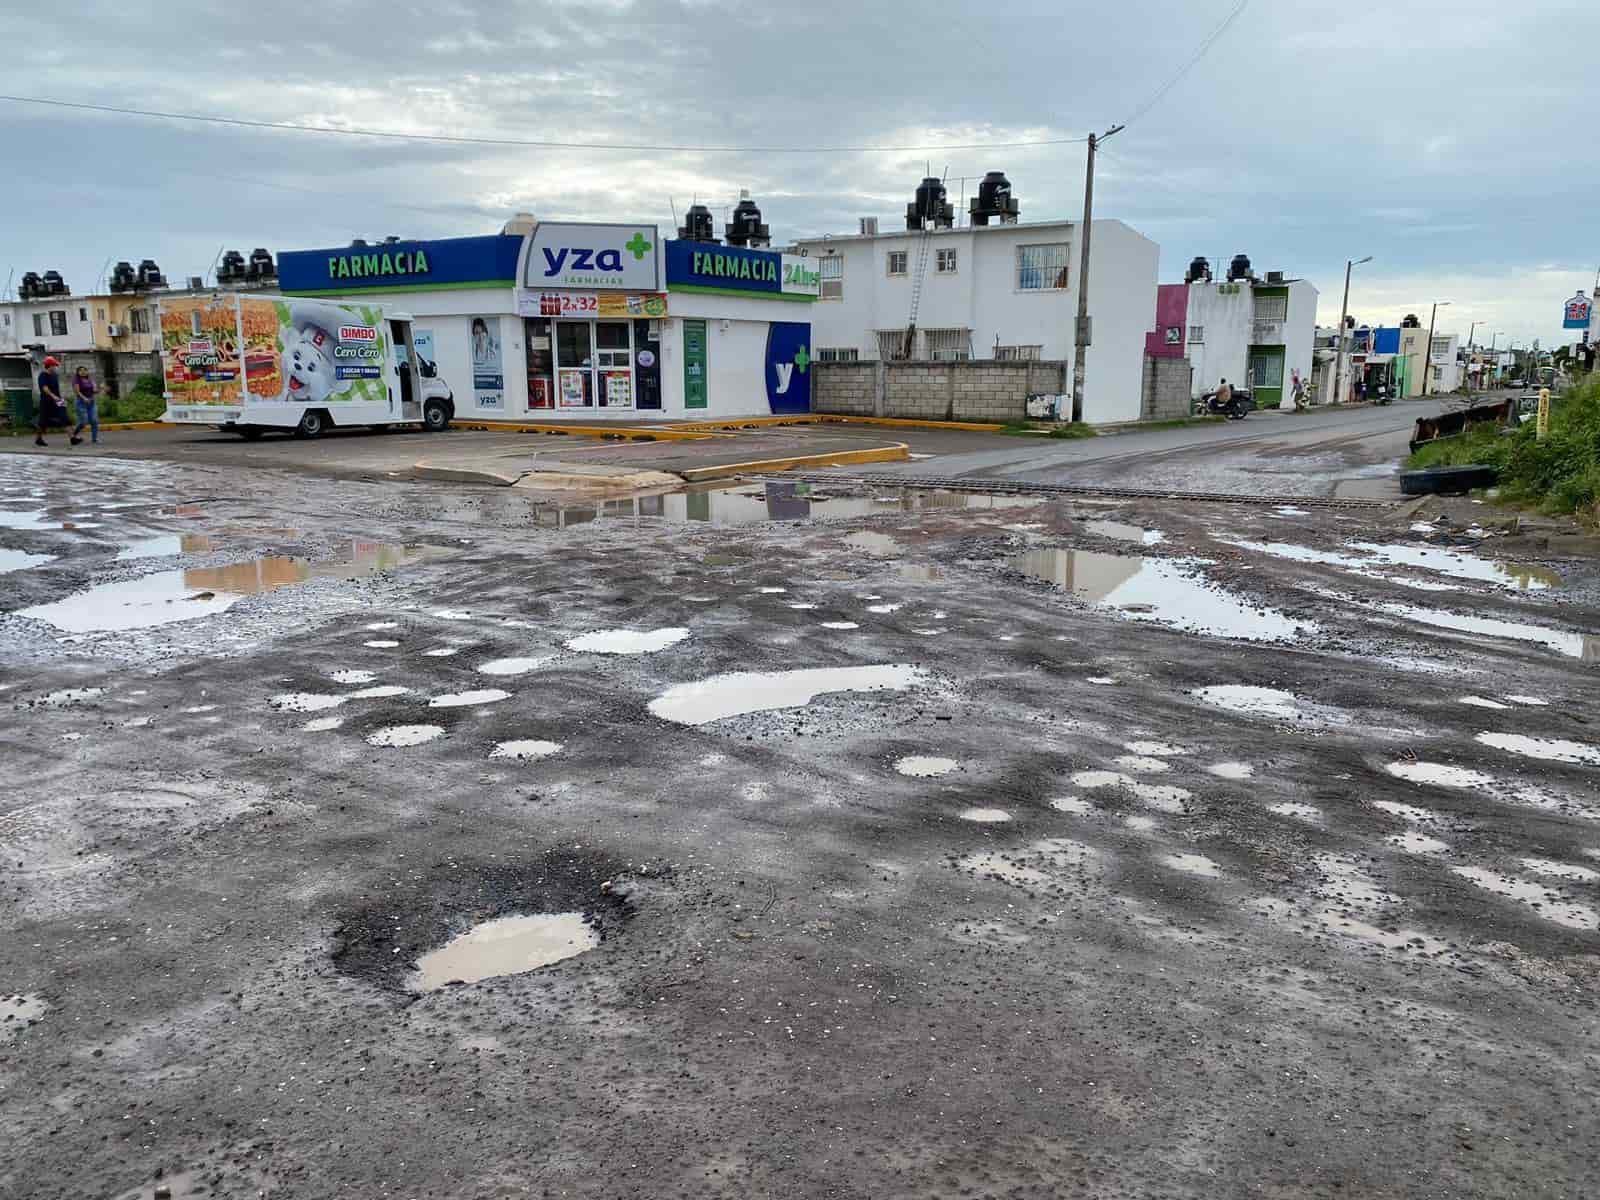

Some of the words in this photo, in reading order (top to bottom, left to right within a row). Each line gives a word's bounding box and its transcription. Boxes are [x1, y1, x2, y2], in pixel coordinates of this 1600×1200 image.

[328, 250, 429, 278] FARMACIA
[542, 248, 624, 277] yza
[693, 251, 777, 281] FARMACIA
[564, 276, 623, 285] FARMACIAS
[341, 327, 375, 339] BIMBO
[334, 346, 357, 357] Cero
[358, 347, 379, 358] Cero
[776, 363, 794, 394] y
[480, 396, 497, 405] yza
